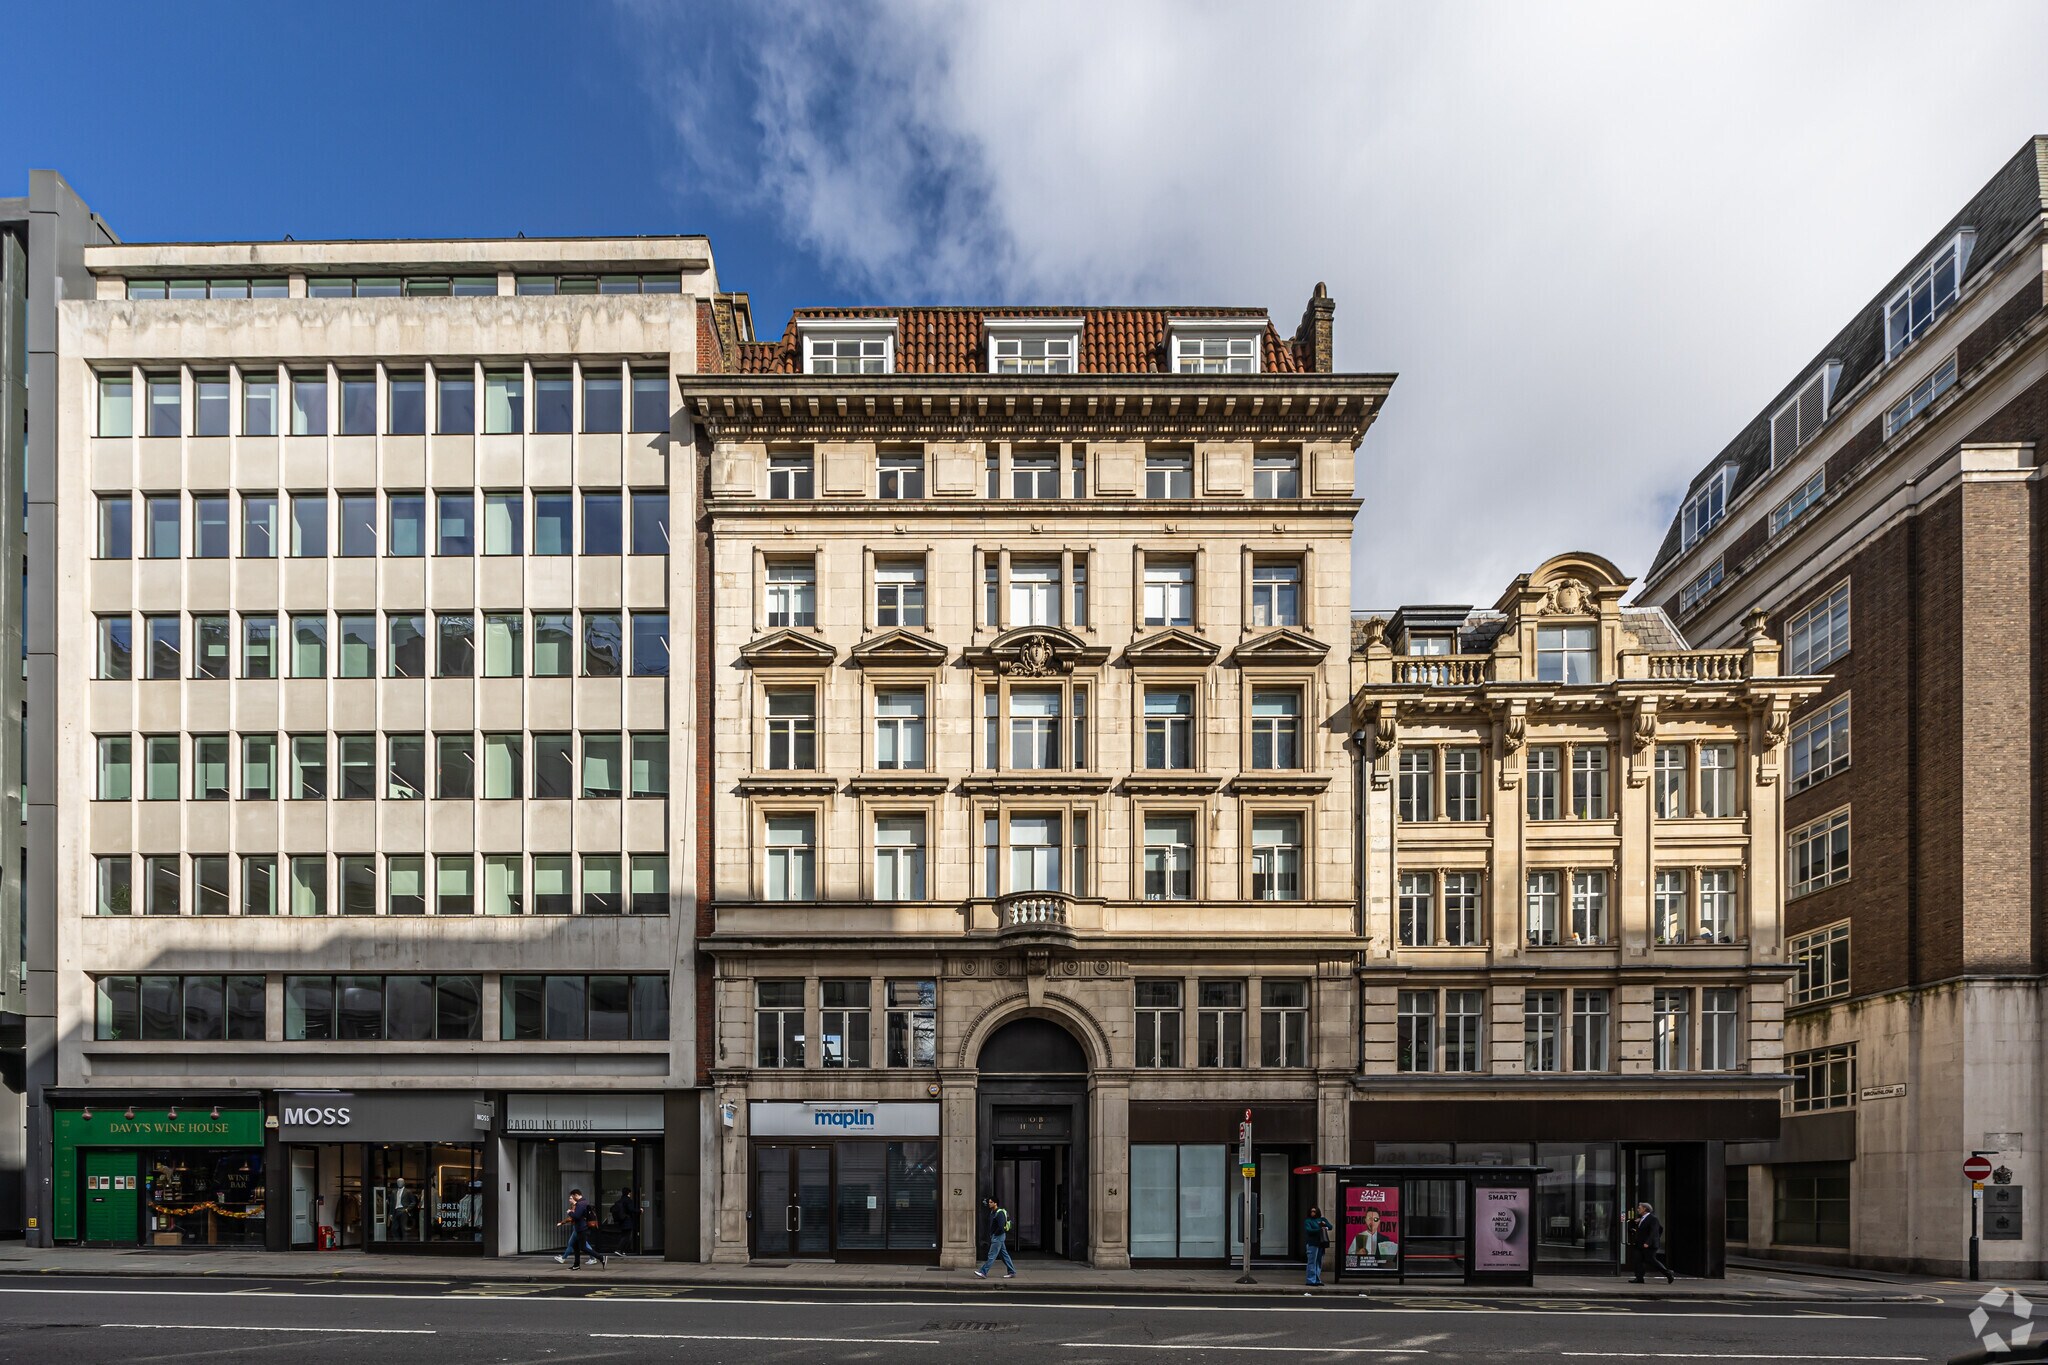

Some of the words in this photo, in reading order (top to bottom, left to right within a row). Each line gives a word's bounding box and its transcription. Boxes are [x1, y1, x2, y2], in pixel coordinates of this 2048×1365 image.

[285, 1107, 351, 1125] MOSS
[476, 1114, 490, 1122] MOSS
[815, 1109, 874, 1128] maplin
[110, 1123, 152, 1133] DAVY'S
[154, 1123, 185, 1133] WINE
[188, 1123, 229, 1133] HOUSE
[508, 1119, 558, 1131] CAROLINE
[562, 1119, 594, 1131] HOUSE
[227, 1174, 249, 1182] WINE
[953, 1188, 963, 1196] 52
[1108, 1188, 1118, 1196] 54
[1360, 1190, 1384, 1198] RARE
[1380, 1222, 1397, 1232] DAY
